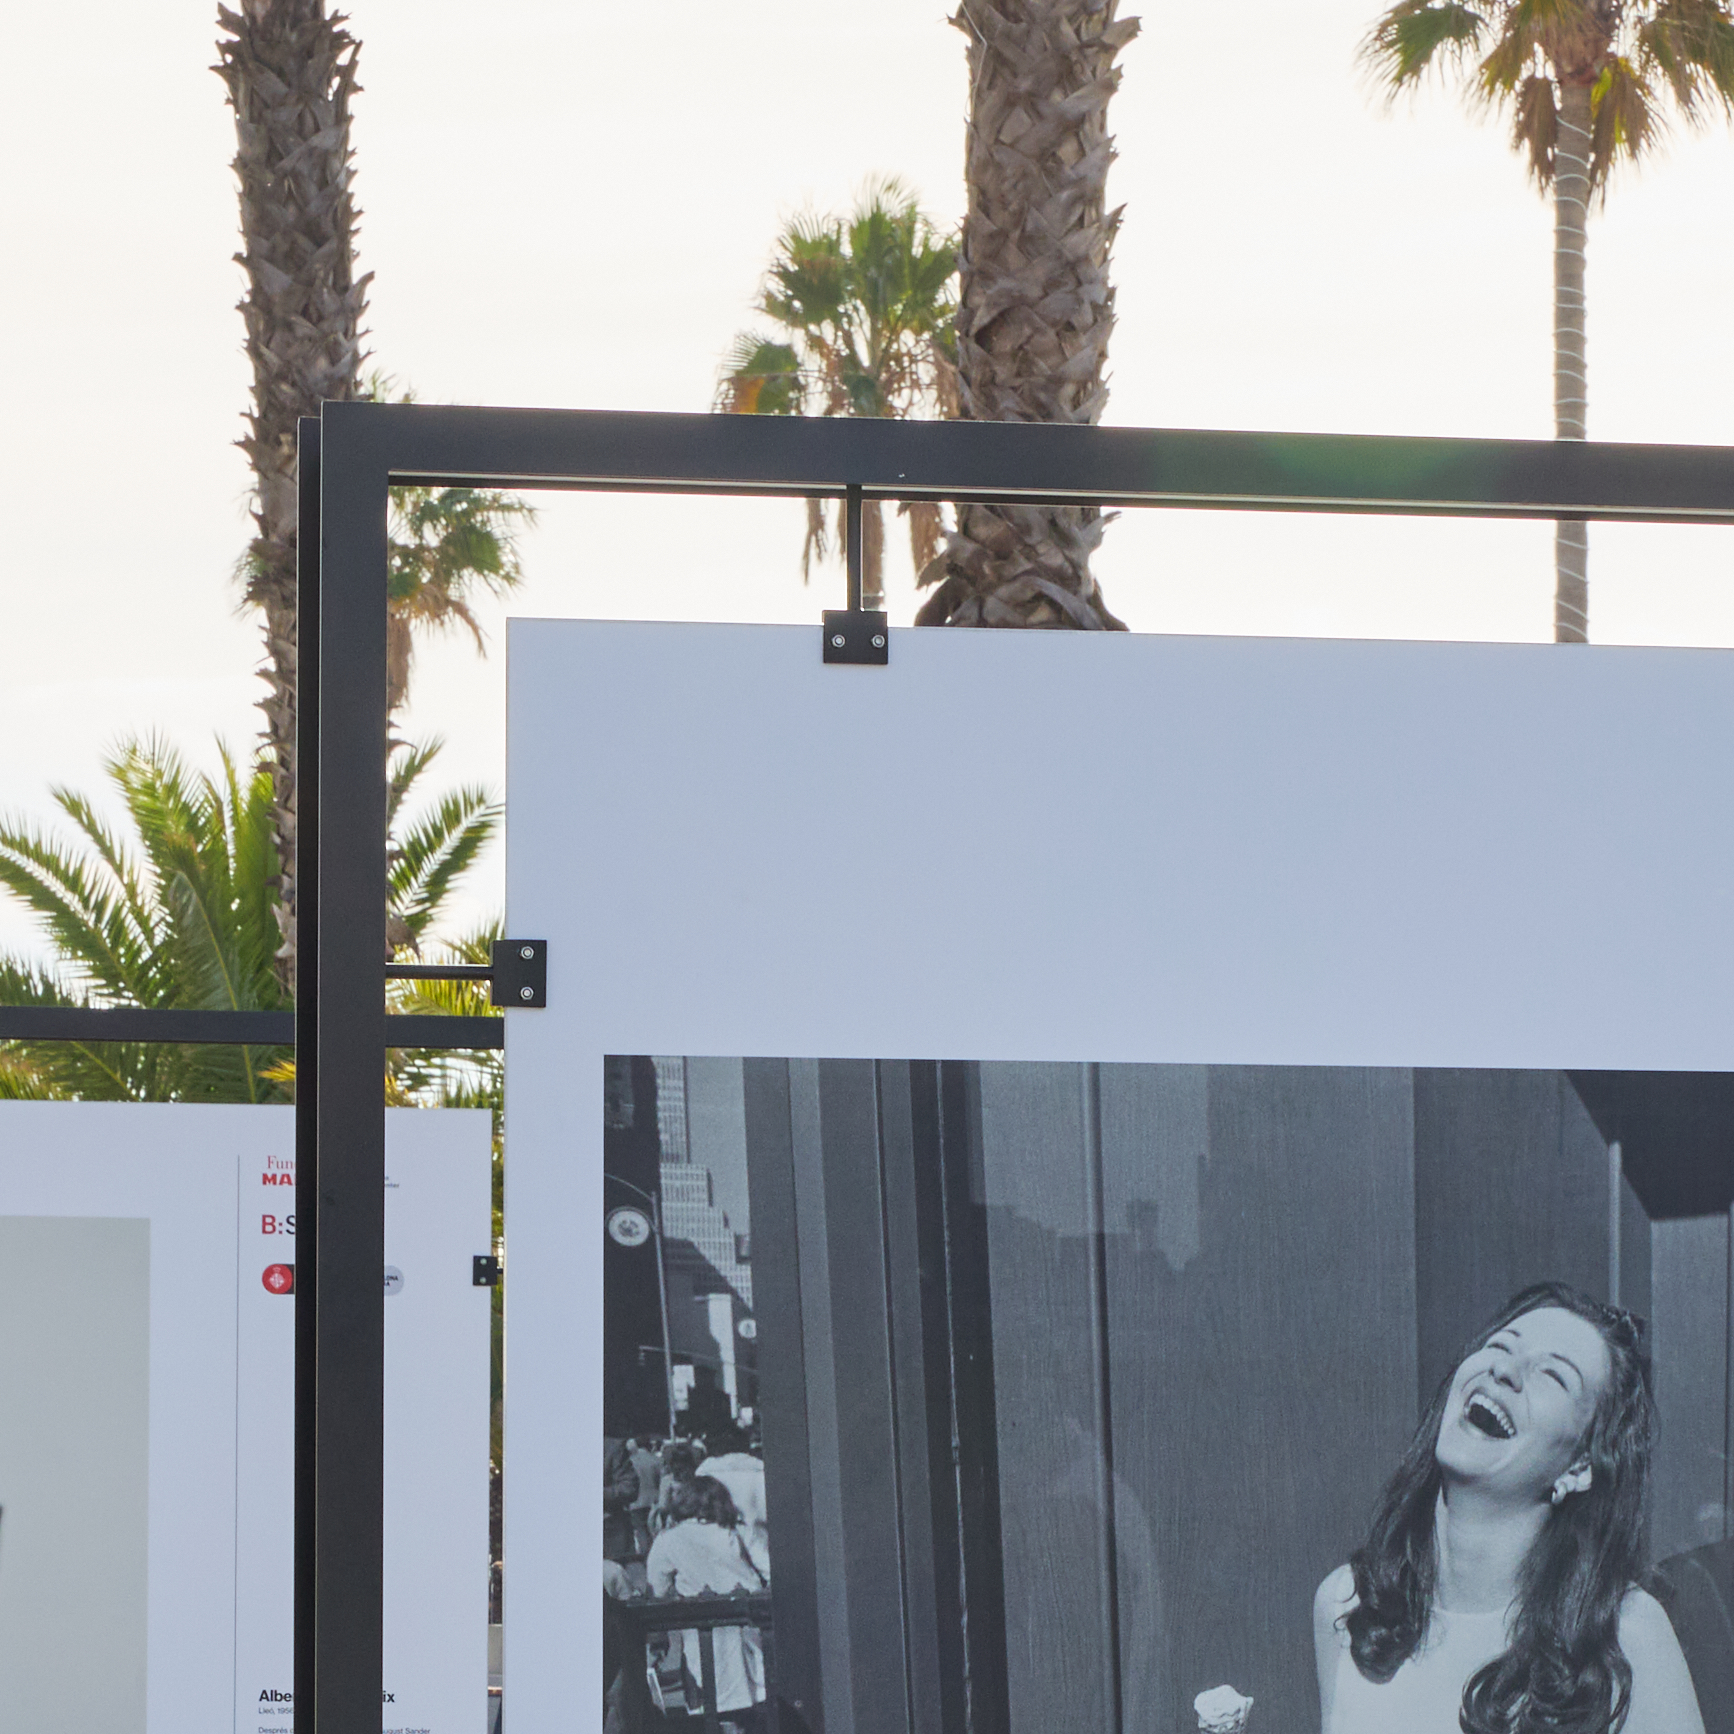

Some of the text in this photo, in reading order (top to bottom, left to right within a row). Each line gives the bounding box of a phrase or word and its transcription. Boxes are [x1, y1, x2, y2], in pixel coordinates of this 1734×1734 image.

[262, 1215, 296, 1234] B:S
[259, 1690, 293, 1702] Albe
[258, 1727, 288, 1734] Després
